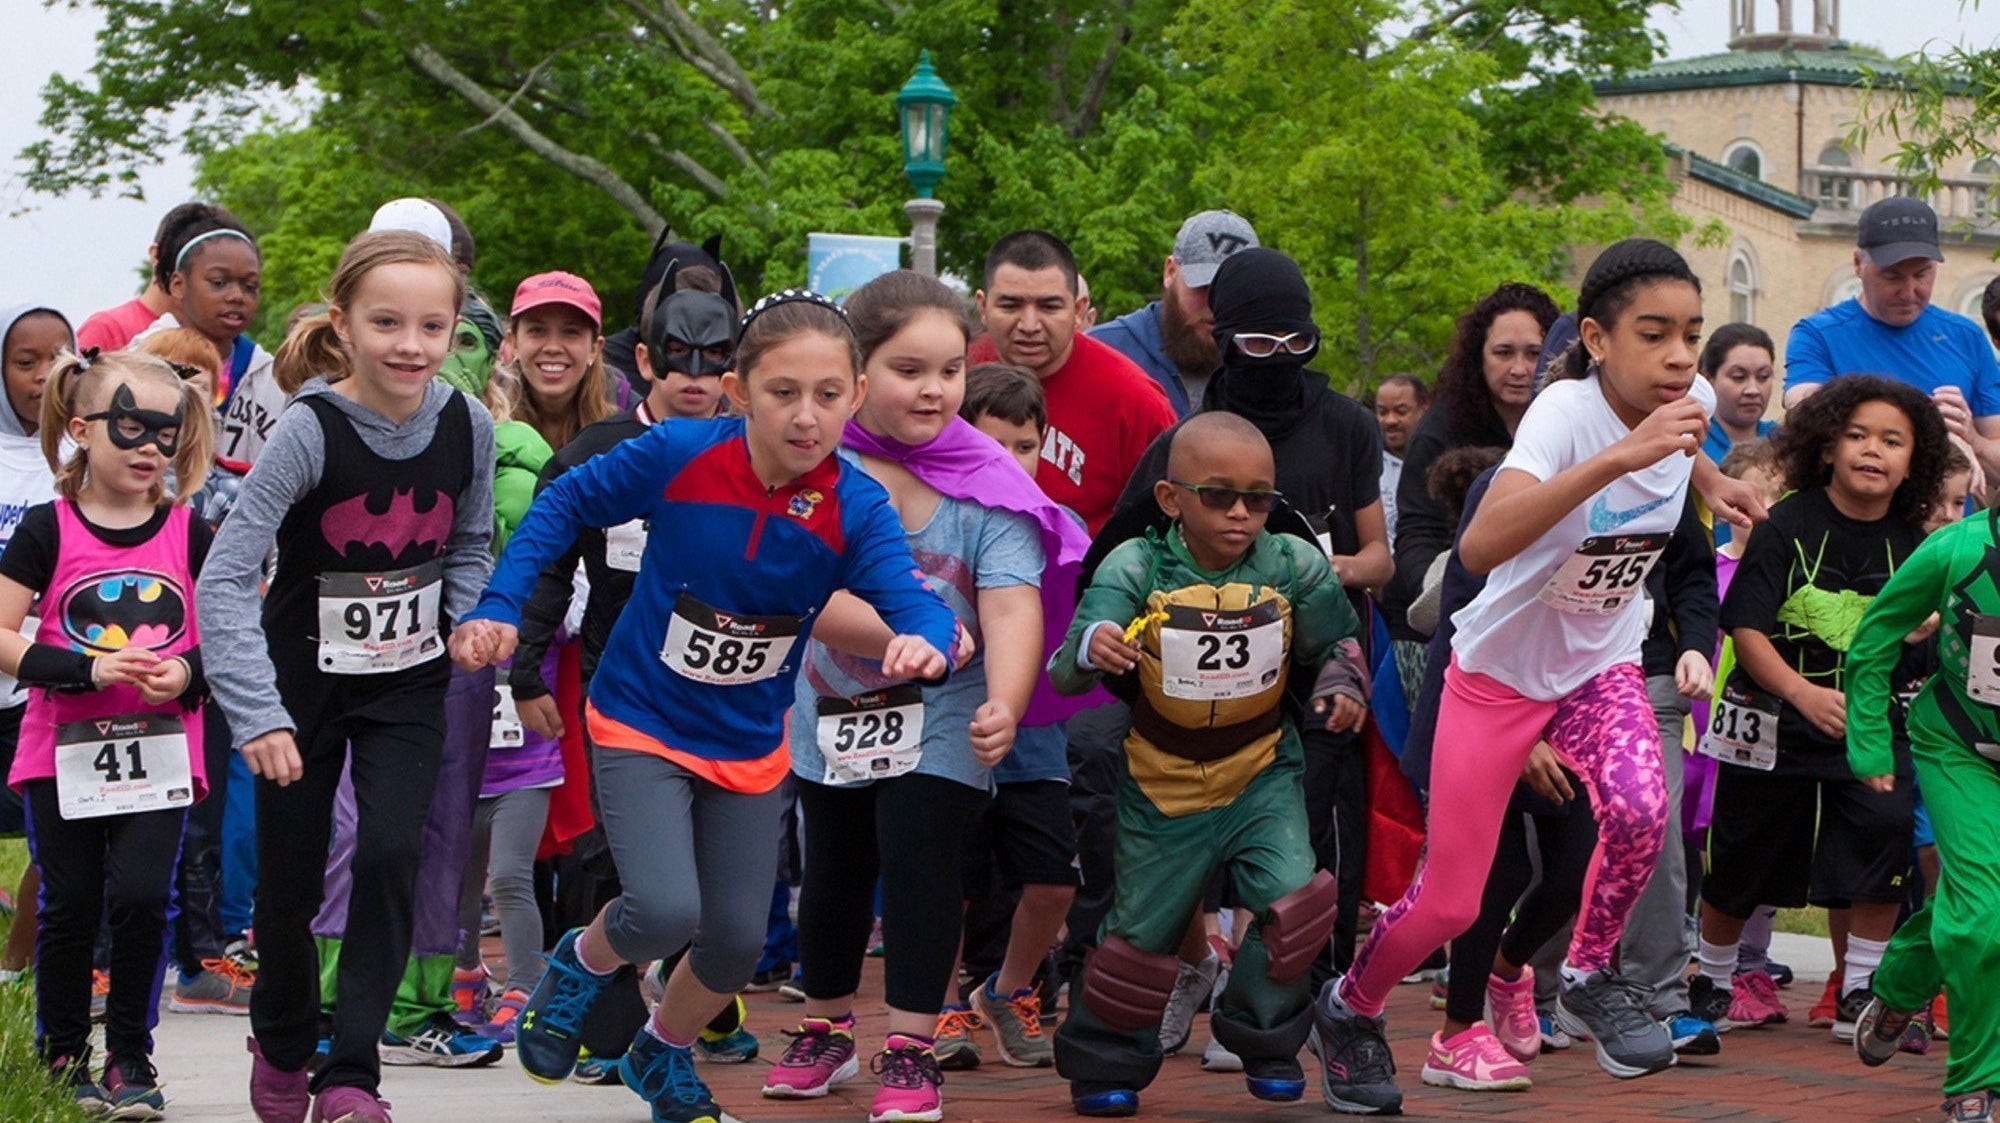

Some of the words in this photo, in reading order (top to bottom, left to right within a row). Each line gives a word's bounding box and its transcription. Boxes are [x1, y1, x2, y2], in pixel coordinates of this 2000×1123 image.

[1881, 216, 1927, 227] TESLA
[1040, 423, 1086, 487] ATE
[1578, 555, 1652, 590] 545
[344, 594, 421, 642] 971
[683, 629, 773, 676] 585
[1196, 633, 1251, 671] 23
[834, 709, 905, 753] 528
[1712, 701, 1762, 745] 813
[93, 740, 148, 783] 41
